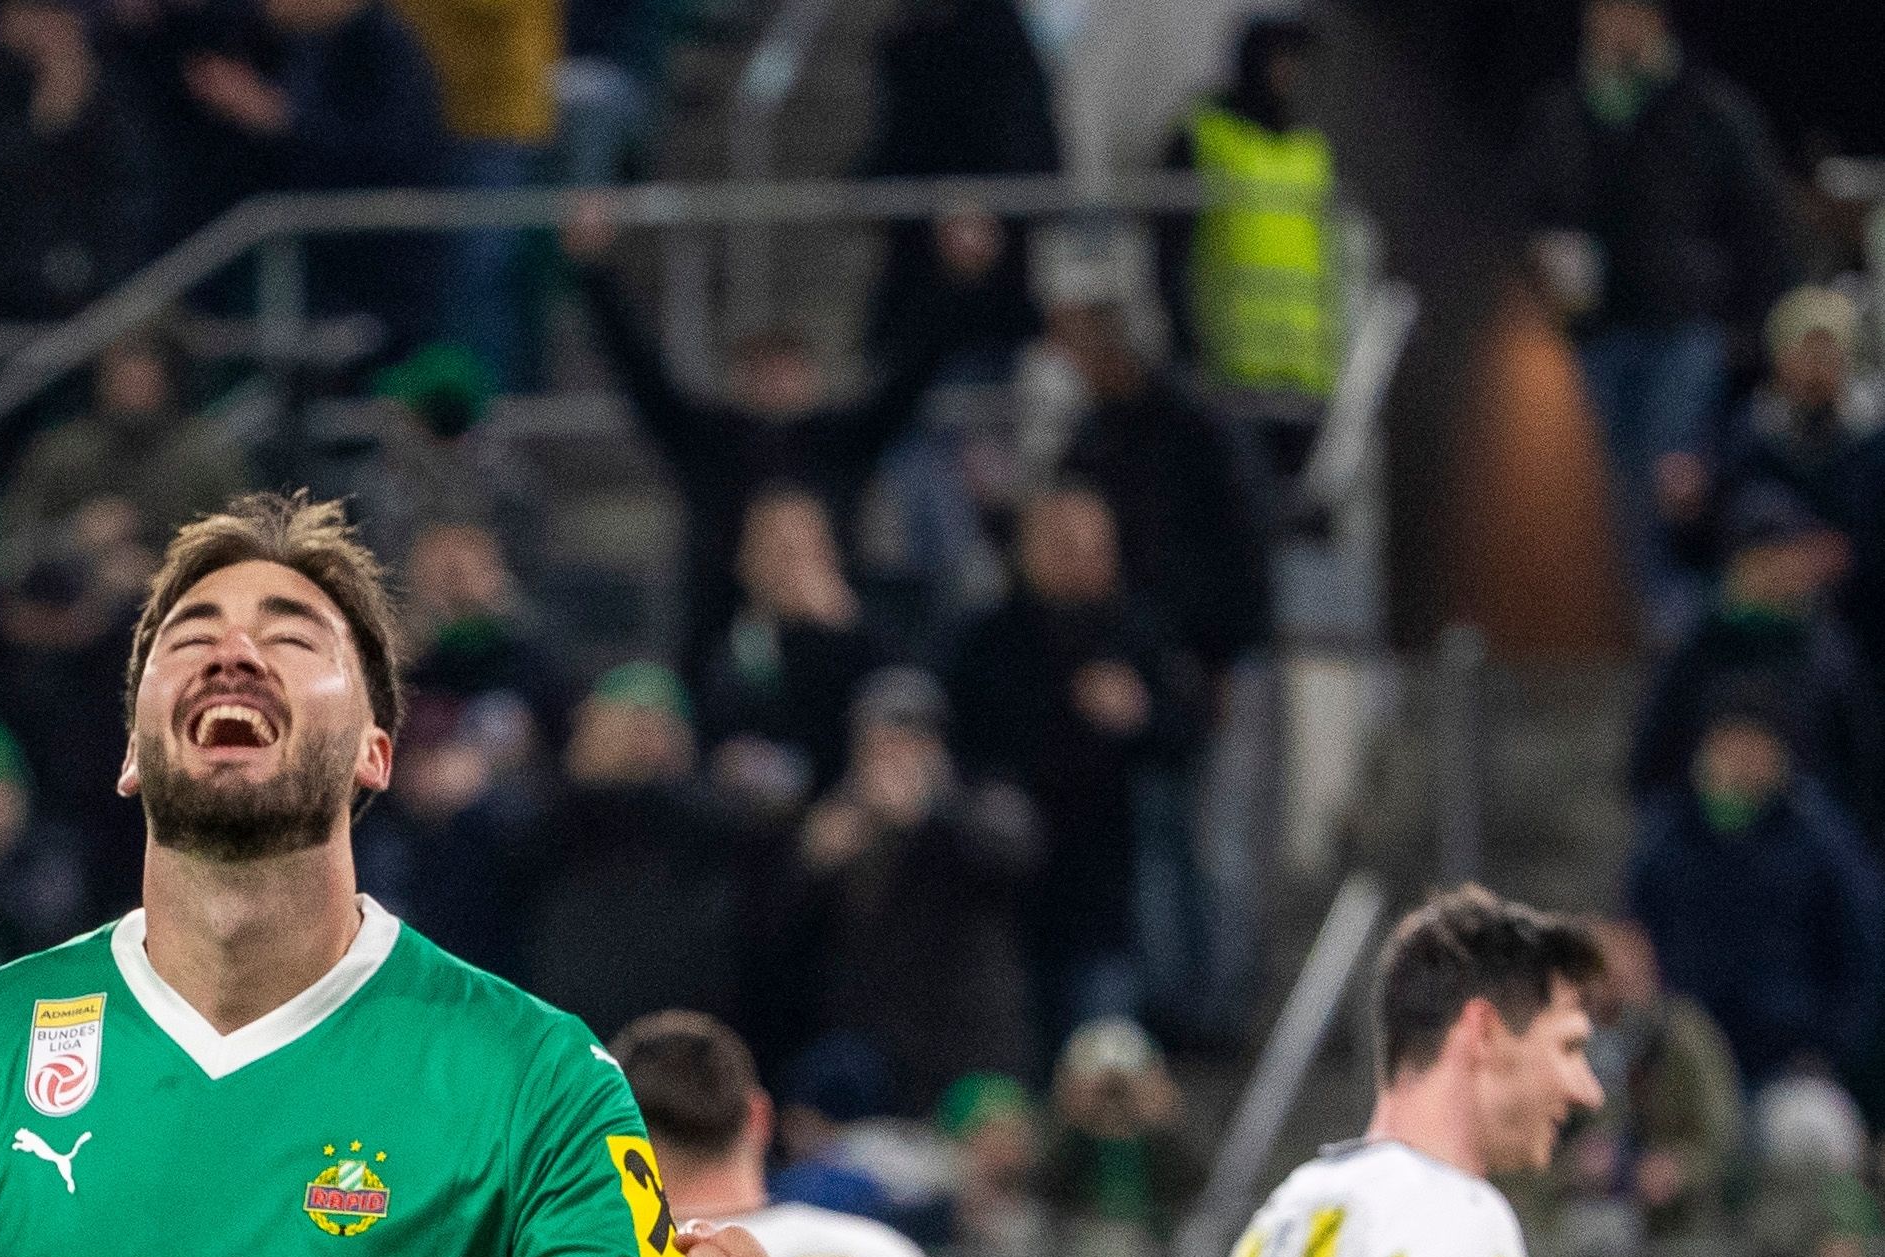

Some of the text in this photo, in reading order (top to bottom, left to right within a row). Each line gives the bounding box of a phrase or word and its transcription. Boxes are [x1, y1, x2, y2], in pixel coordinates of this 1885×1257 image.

[36, 1023, 96, 1042] BUNDES
[49, 1039, 82, 1053] LIGA
[311, 1186, 385, 1212] RAPID
